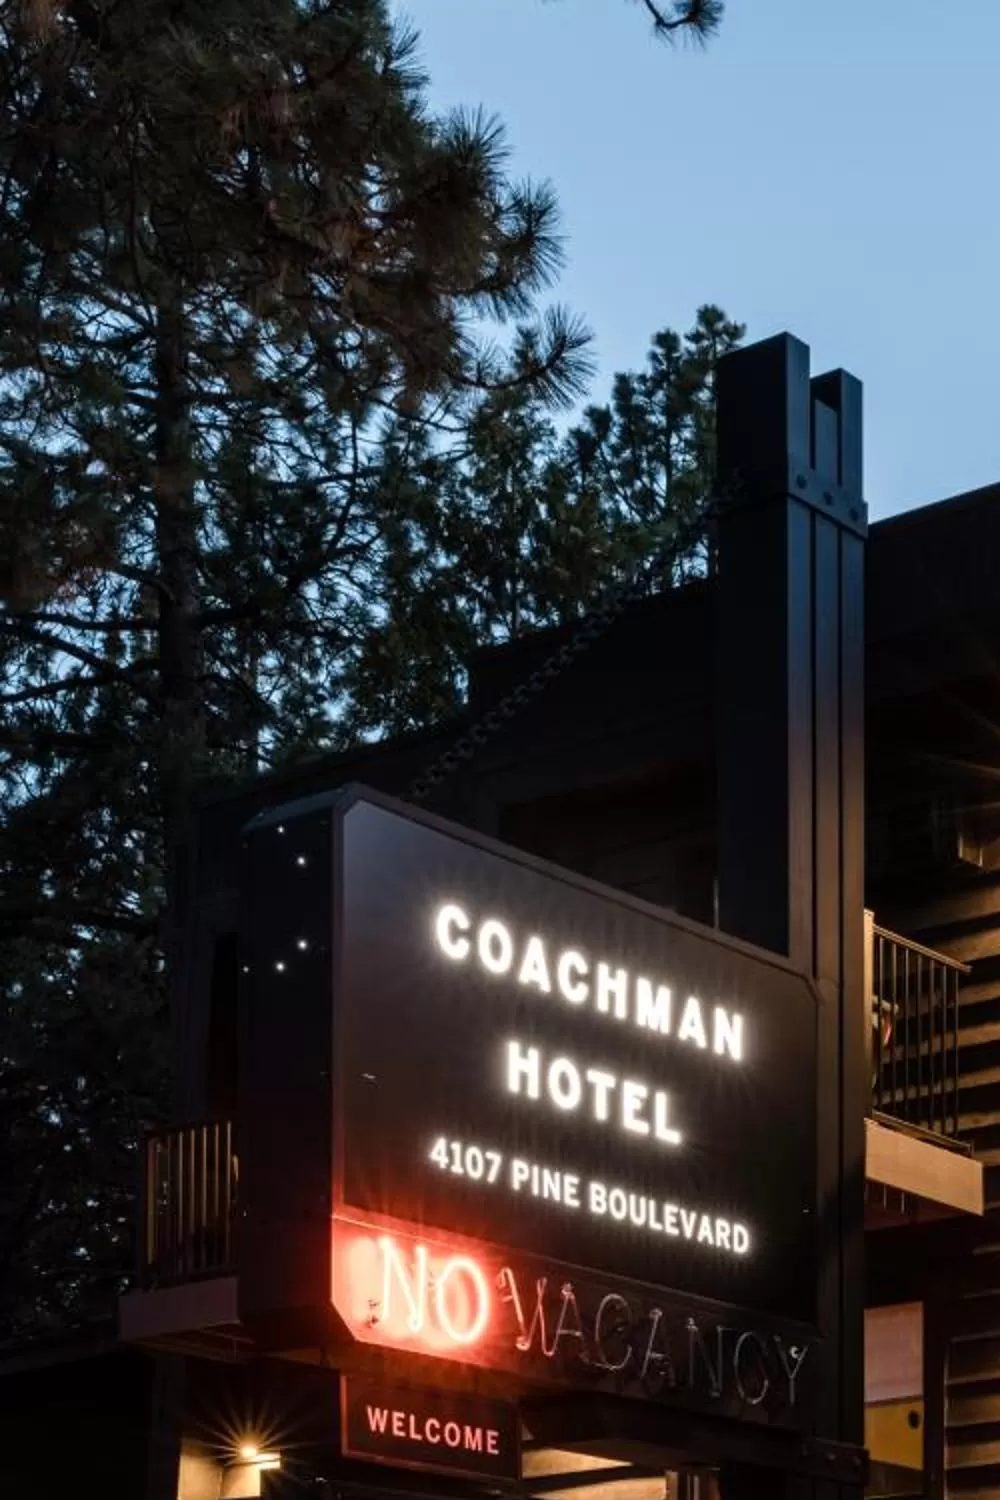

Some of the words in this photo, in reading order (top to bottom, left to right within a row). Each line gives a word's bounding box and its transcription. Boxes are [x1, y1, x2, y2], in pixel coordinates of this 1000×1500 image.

[435, 903, 744, 1060] COACHMAN
[507, 1042, 682, 1144] HOTEL
[430, 1137, 501, 1184] 4107
[511, 1159, 581, 1208] PINE
[590, 1182, 751, 1255] BOULEVARD
[376, 1236, 488, 1343] NO
[500, 1267, 809, 1406] VACANCY
[367, 1406, 500, 1454] WELCOME
